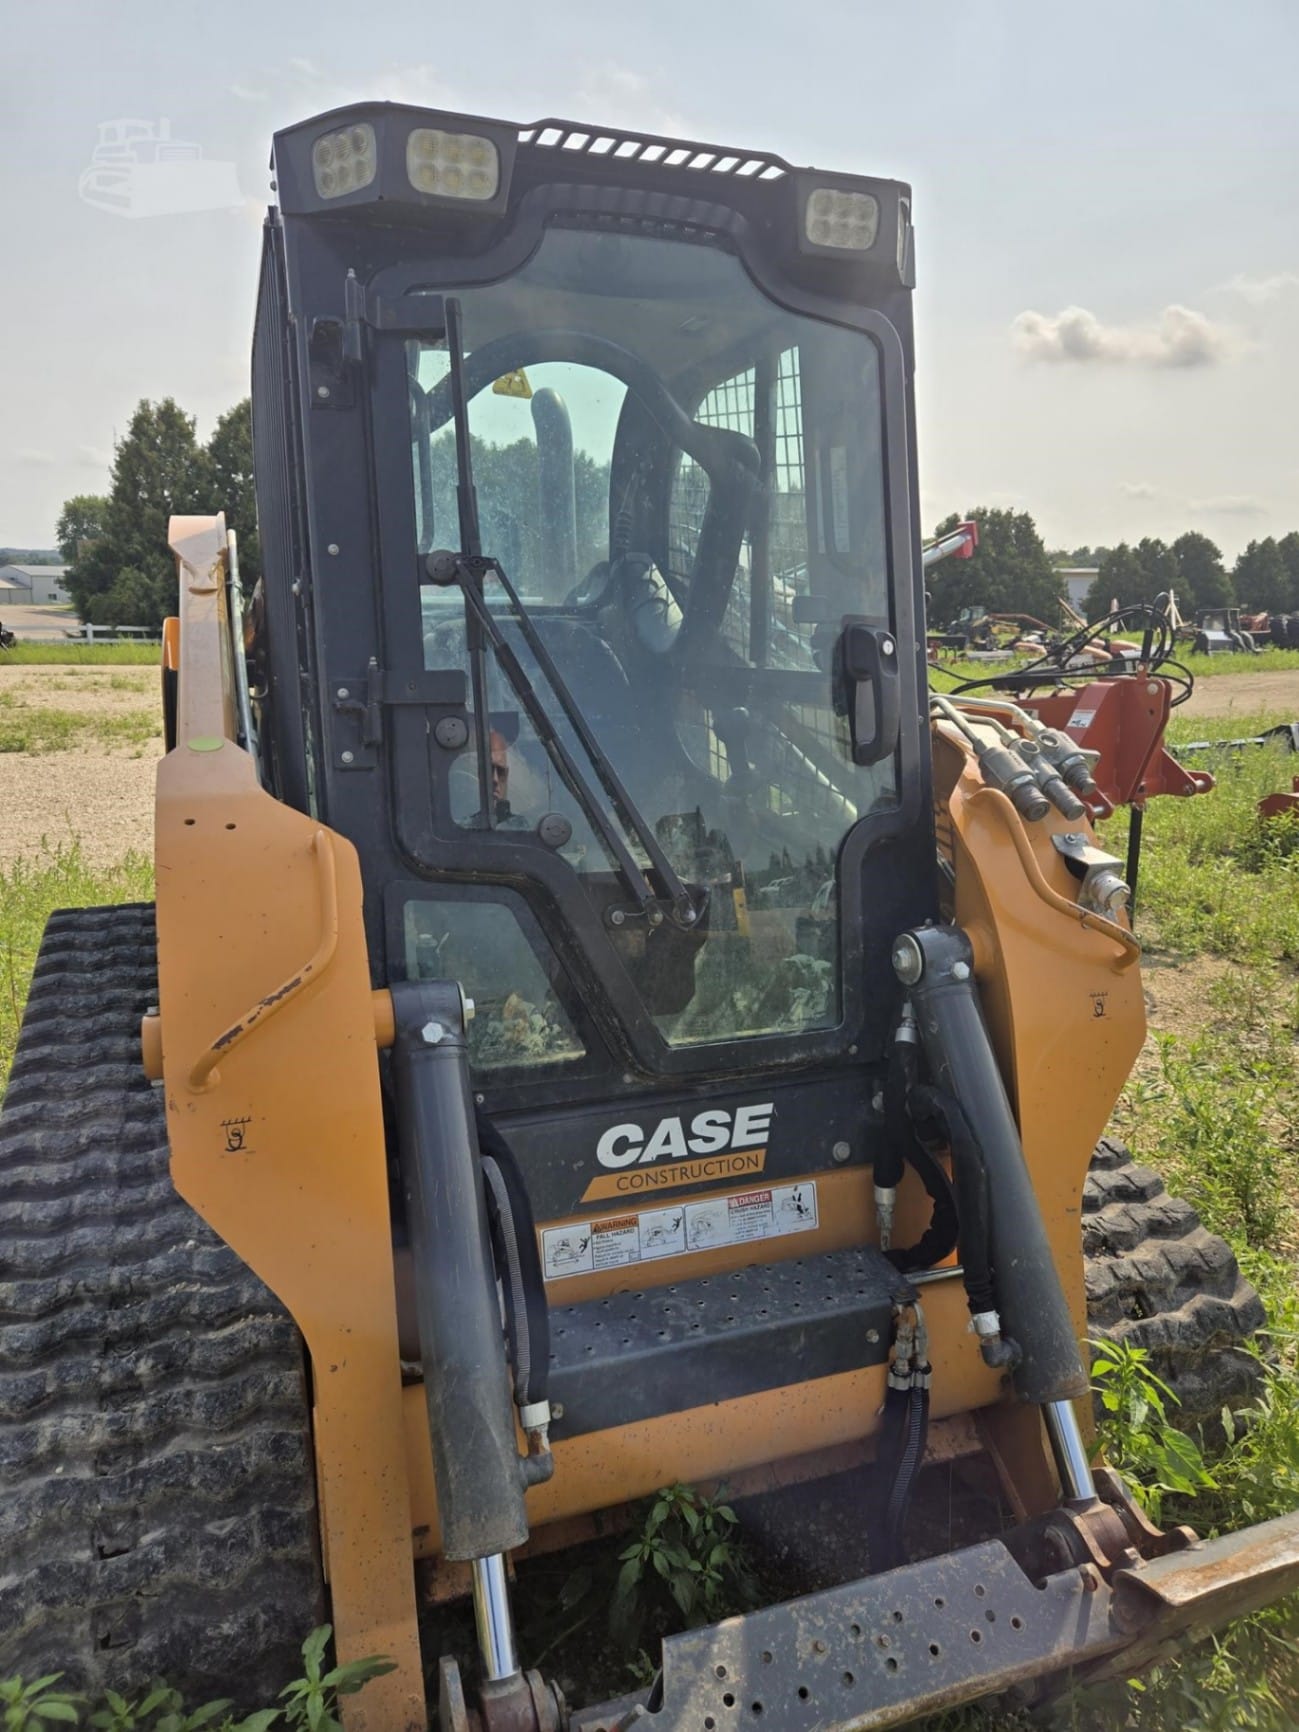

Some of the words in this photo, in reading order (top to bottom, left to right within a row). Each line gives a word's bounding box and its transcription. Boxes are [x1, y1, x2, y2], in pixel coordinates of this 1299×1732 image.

[596, 1103, 774, 1168] CASE
[616, 1153, 760, 1192] CONSTRUCTION
[739, 1192, 770, 1206] DANGER
[600, 1216, 637, 1231] WARNING
[611, 1228, 635, 1237] HAZARD
